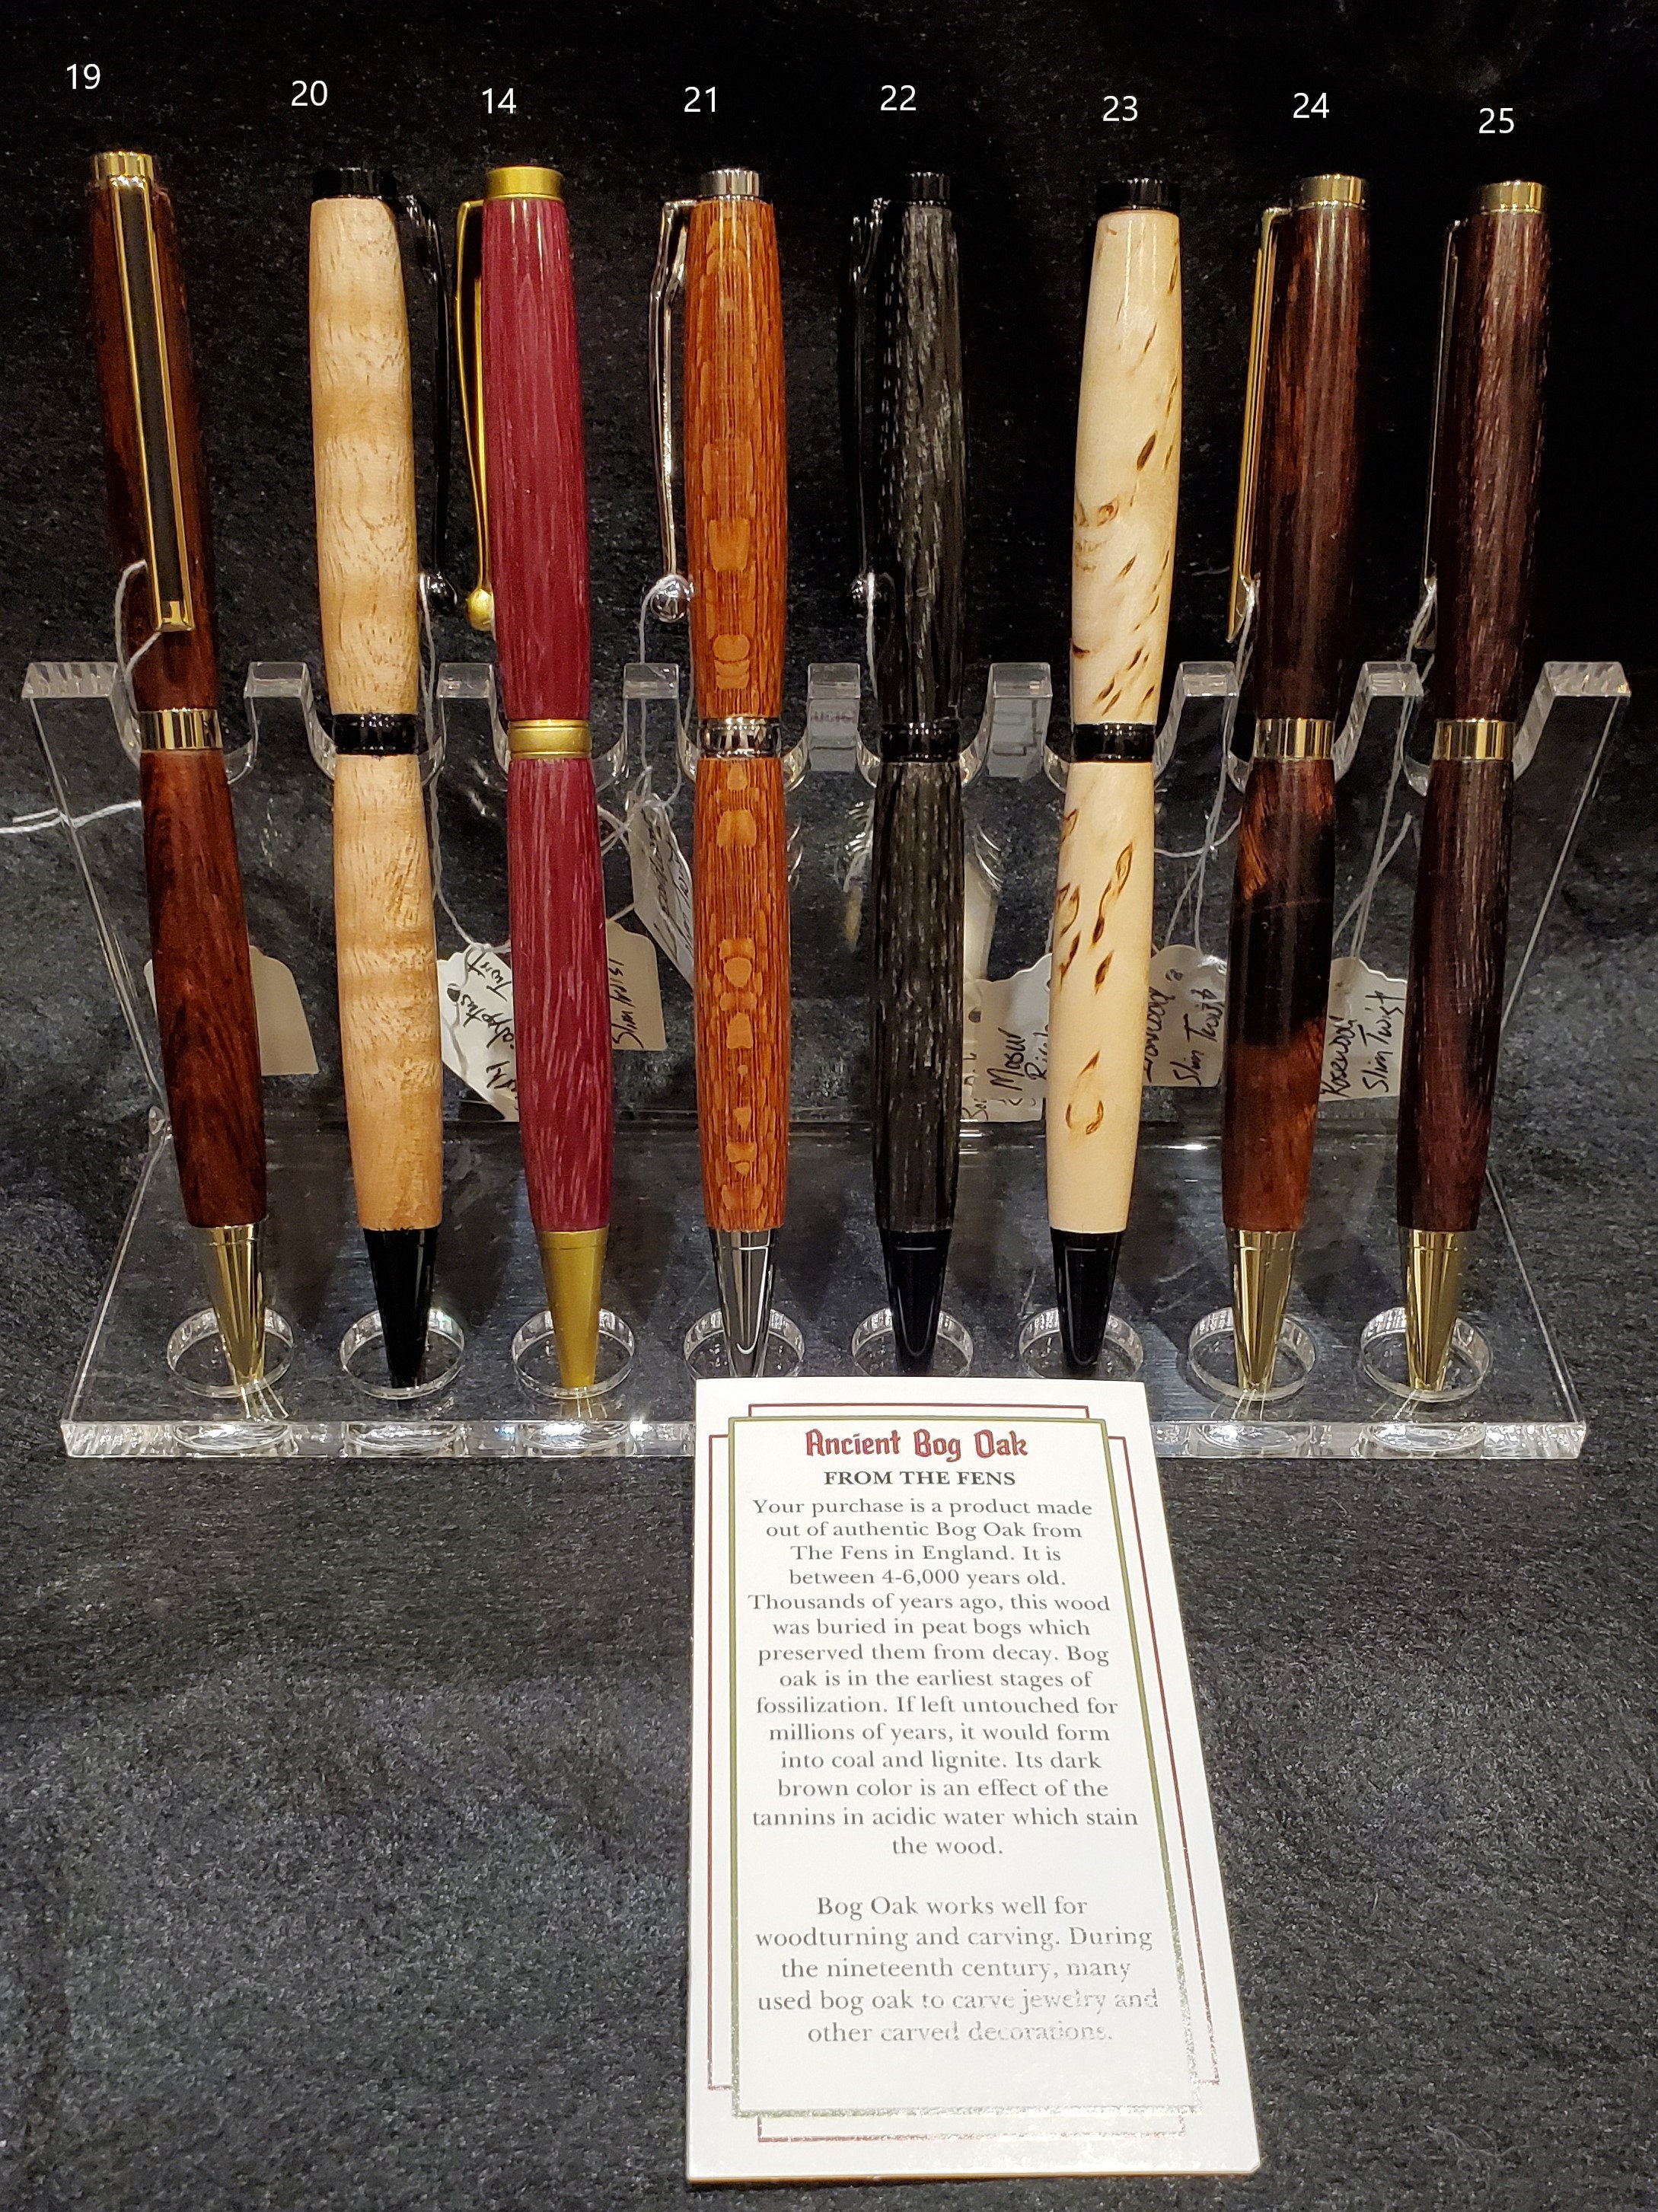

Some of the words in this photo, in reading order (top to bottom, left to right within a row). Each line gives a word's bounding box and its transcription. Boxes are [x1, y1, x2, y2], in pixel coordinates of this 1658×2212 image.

[1183, 989, 1224, 1043] Twist
[1357, 990, 1405, 1047] Twist
[1170, 1050, 1204, 1085] Slim
[1361, 1050, 1394, 1092] Slim
[805, 1428, 901, 1457] Ancient
[913, 1428, 962, 1463] Bog
[973, 1429, 1029, 1459] Oak
[823, 1471, 894, 1486] FROM
[899, 1471, 951, 1485] THE
[955, 1471, 1016, 1486] FENS
[752, 1499, 805, 1514] Your
[811, 1497, 904, 1519] purchase
[910, 1497, 925, 1513] is
[931, 1502, 943, 1513] a
[949, 1498, 1031, 1518] product
[1035, 1500, 1092, 1516] made
[766, 1524, 801, 1537] out
[806, 1521, 830, 1537] of
[833, 1520, 929, 1536] authentic
[935, 1521, 977, 1541] Bog
[983, 1522, 1027, 1537] Oak
[1032, 1522, 1082, 1538] from
[789, 1544, 833, 1560] The
[840, 1545, 888, 1560] Fens
[894, 1544, 915, 1560] in
[921, 1544, 1015, 1565] England.
[1022, 1545, 1041, 1561] It
[1045, 1545, 1061, 1561] is
[789, 1569, 875, 1585] between
[882, 1568, 960, 1587] 4-6,000
[965, 1573, 1020, 1589] years
[1026, 1569, 1066, 1586] old.
[747, 1592, 866, 1610] Thousands
[872, 1592, 895, 1609] of
[898, 1597, 953, 1614] years
[959, 1598, 1003, 1614] ago,
[1010, 1593, 1047, 1610] this
[1053, 1595, 1111, 1611] wood
[772, 1623, 810, 1635] was
[816, 1617, 887, 1635] buried
[894, 1618, 914, 1634] in
[921, 1621, 968, 1640] peat
[972, 1618, 1022, 1640] bogs
[1027, 1618, 1091, 1636] which
[758, 1643, 864, 1667] preserved
[872, 1643, 926, 1660] them
[933, 1643, 985, 1660] from
[992, 1643, 1059, 1667] decay.
[1065, 1645, 1109, 1668] Bog
[779, 1669, 818, 1687] oak
[825, 1669, 840, 1687] is
[847, 1669, 869, 1686] in
[875, 1669, 910, 1686] the
[916, 1669, 994, 1687] earliest
[1000, 1672, 1063, 1693] stages
[1070, 1670, 1094, 1688] of
[756, 1695, 888, 1714] fossilization.
[896, 1695, 917, 1713] If
[920, 1695, 956, 1713] left
[962, 1696, 1080, 1714] untouched
[1087, 1697, 1118, 1714] for
[769, 1723, 855, 1741] millions
[862, 1722, 887, 1740] of
[890, 1728, 953, 1746] years,
[961, 1722, 976, 1740] it
[982, 1723, 1049, 1741] would
[1057, 1723, 1111, 1742] form
[781, 1750, 824, 1769] into
[831, 1749, 875, 1768] coal
[882, 1749, 923, 1768] and
[931, 1749, 1007, 1774] lignite.
[1015, 1751, 1043, 1768] Its
[1050, 1750, 1102, 1769] dark
[777, 1778, 850, 1797] brown
[856, 1777, 913, 1796] color
[920, 1777, 936, 1796] is
[943, 1783, 971, 1796] an
[977, 1777, 1038, 1797] effect
[1044, 1778, 1069, 1797] of
[1073, 1778, 1108, 1797] the
[752, 1807, 836, 1827] tannins
[843, 1806, 865, 1826] in
[872, 1806, 936, 1825] acidic
[942, 1810, 1006, 1825] water
[1012, 1806, 1079, 1826] which
[1086, 1807, 1139, 1826] stain
[892, 1835, 928, 1855] the
[935, 1835, 1003, 1855] wood.
[817, 1897, 863, 1922] Bog
[870, 1895, 919, 1915] Oak
[926, 1895, 994, 1915] works
[1001, 1895, 1047, 1915] well
[1054, 1895, 1088, 1914] for
[755, 1926, 909, 1952] woodturning
[916, 1926, 960, 1946] and
[968, 1925, 1060, 1952] carving.
[1068, 1926, 1153, 1952] During
[781, 1958, 818, 1978] the
[827, 1957, 954, 1978] nineteenth
[961, 1962, 1059, 1984] century,
[1066, 1962, 1131, 1983] many
[758, 1989, 812, 2010] used
[819, 1989, 864, 2016] bog
[872, 1988, 914, 2010] oak
[922, 1991, 945, 2009] to
[952, 1995, 1015, 2009] carve
[1019, 1988, 1106, 2016] jewelry
[1114, 1987, 1159, 2008] and
[808, 2022, 873, 2042] other
[880, 2020, 960, 2041] carved
[968, 2020, 1113, 2041] decorations.
